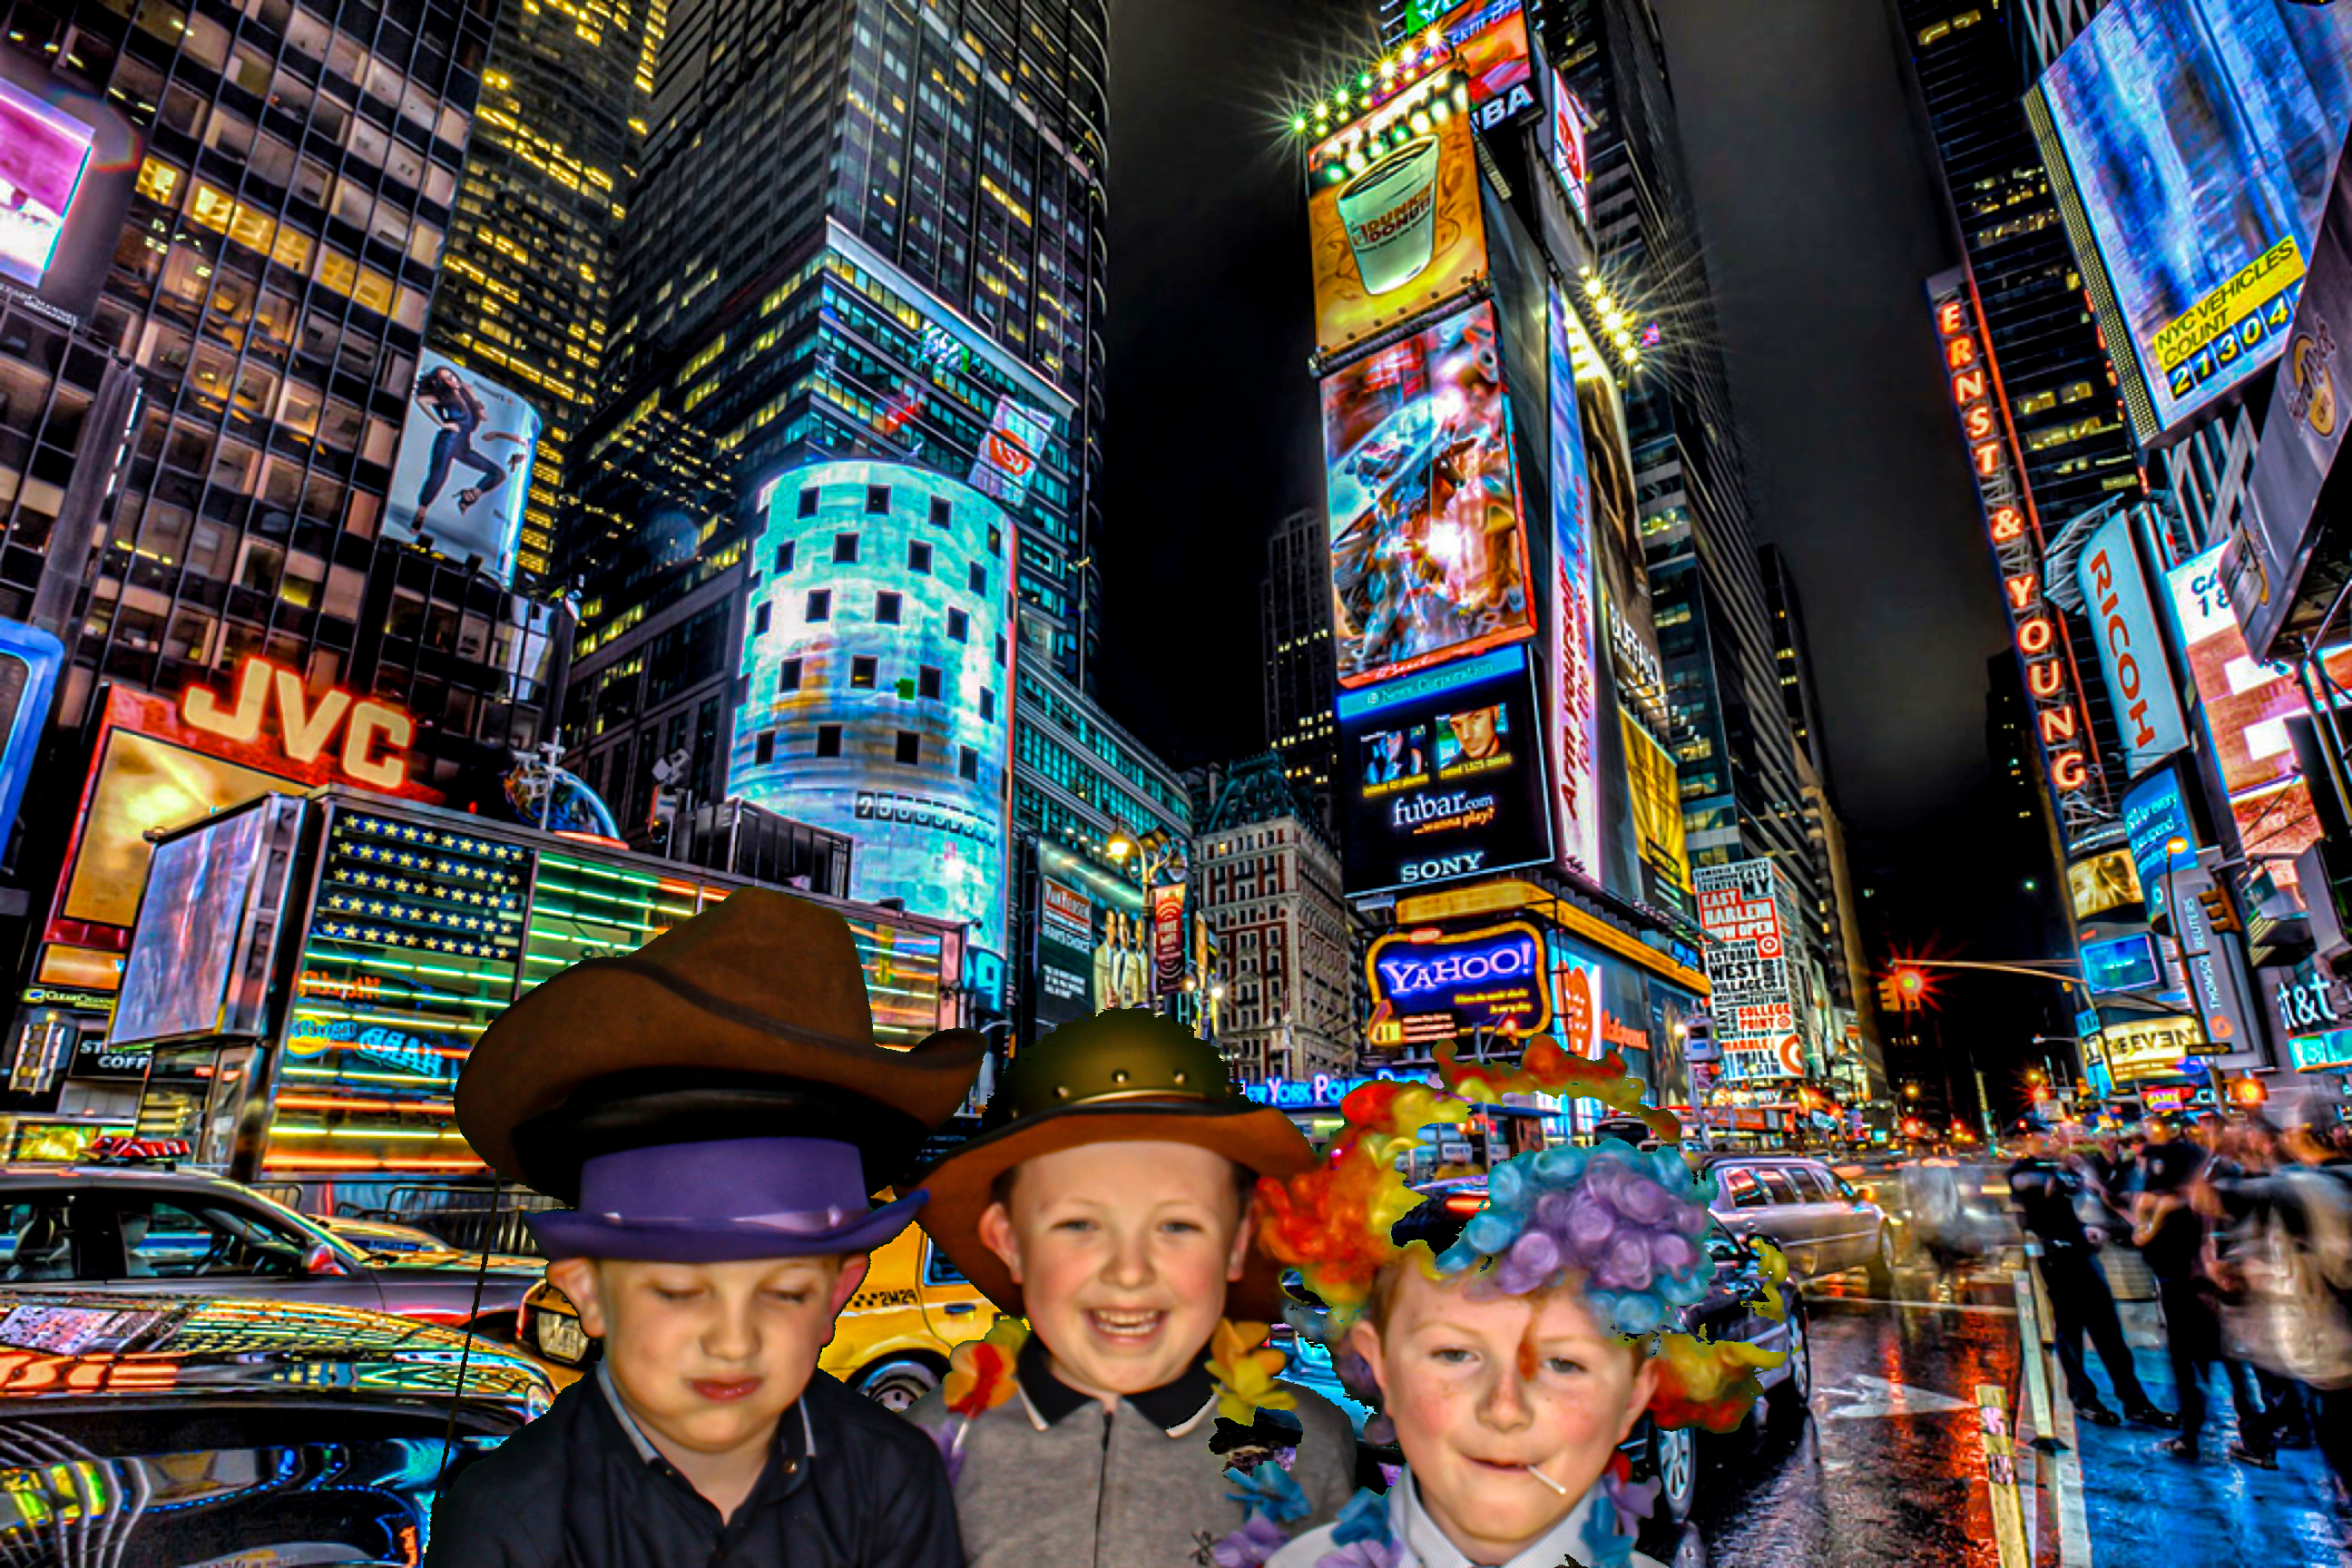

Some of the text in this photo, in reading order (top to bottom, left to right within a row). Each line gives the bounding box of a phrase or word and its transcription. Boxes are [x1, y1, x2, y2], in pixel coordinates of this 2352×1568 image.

[2157, 239, 2295, 350] NYC VEHICLES
[2163, 306, 2230, 366] COUNT
[1938, 302, 2086, 790] ERNST & YOUNG
[2089, 549, 2155, 749] RICOH
[1417, 662, 1494, 691] Corporation
[1558, 555, 1578, 820] Arm yourself
[1576, 663, 1589, 720] the
[182, 656, 412, 789] JVC
[1577, 730, 1590, 776] for
[1393, 790, 1494, 827] fubar.com
[1400, 849, 1484, 882] SONY
[1701, 890, 1737, 907] EAST
[1703, 901, 1772, 926] HARLEM
[1739, 920, 1775, 936] OPEN
[2182, 896, 2207, 950] REUTERS
[1378, 941, 1532, 995] YAHOO!
[1710, 961, 1758, 981] WEST
[1738, 1002, 1790, 1018] COLLEGE
[97, 1054, 150, 1070] COFF
[1267, 1076, 1313, 1103] YORK
